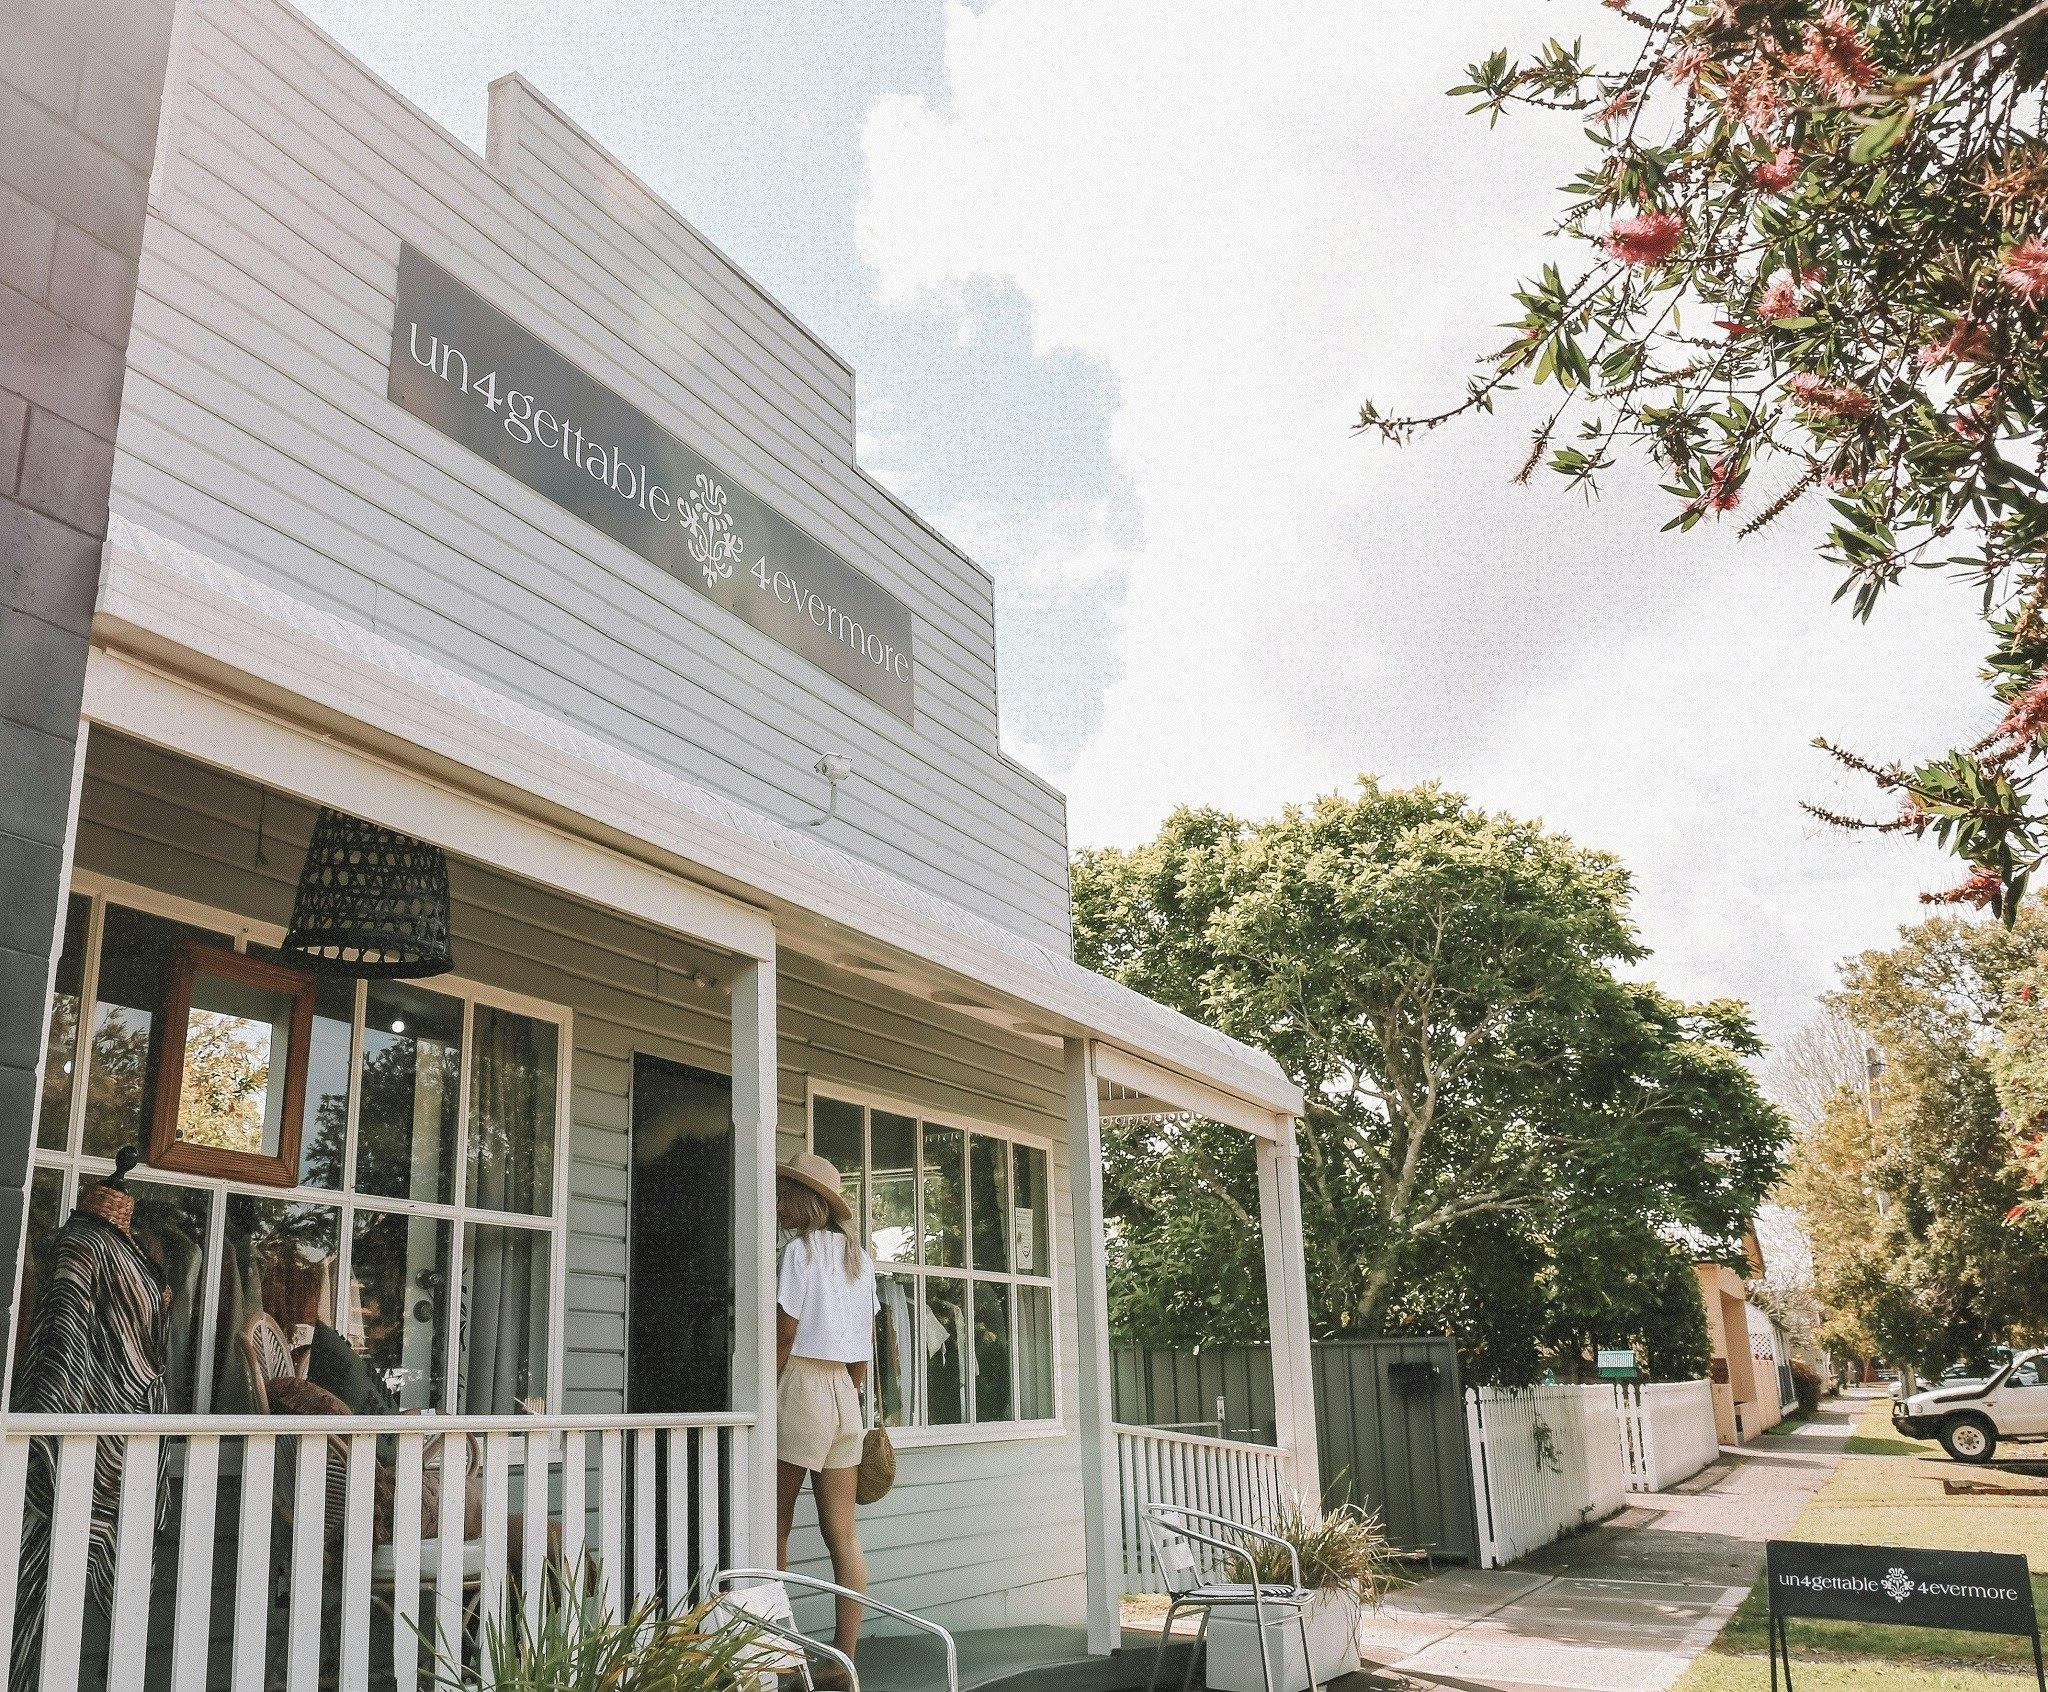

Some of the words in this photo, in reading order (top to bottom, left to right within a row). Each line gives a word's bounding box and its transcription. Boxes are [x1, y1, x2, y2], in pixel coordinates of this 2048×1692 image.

[408, 321, 671, 522] un4gettable
[749, 555, 909, 683] 4evermore
[1779, 1574, 1879, 1592] un4gettable
[1917, 1580, 2018, 1600] 4evermore
